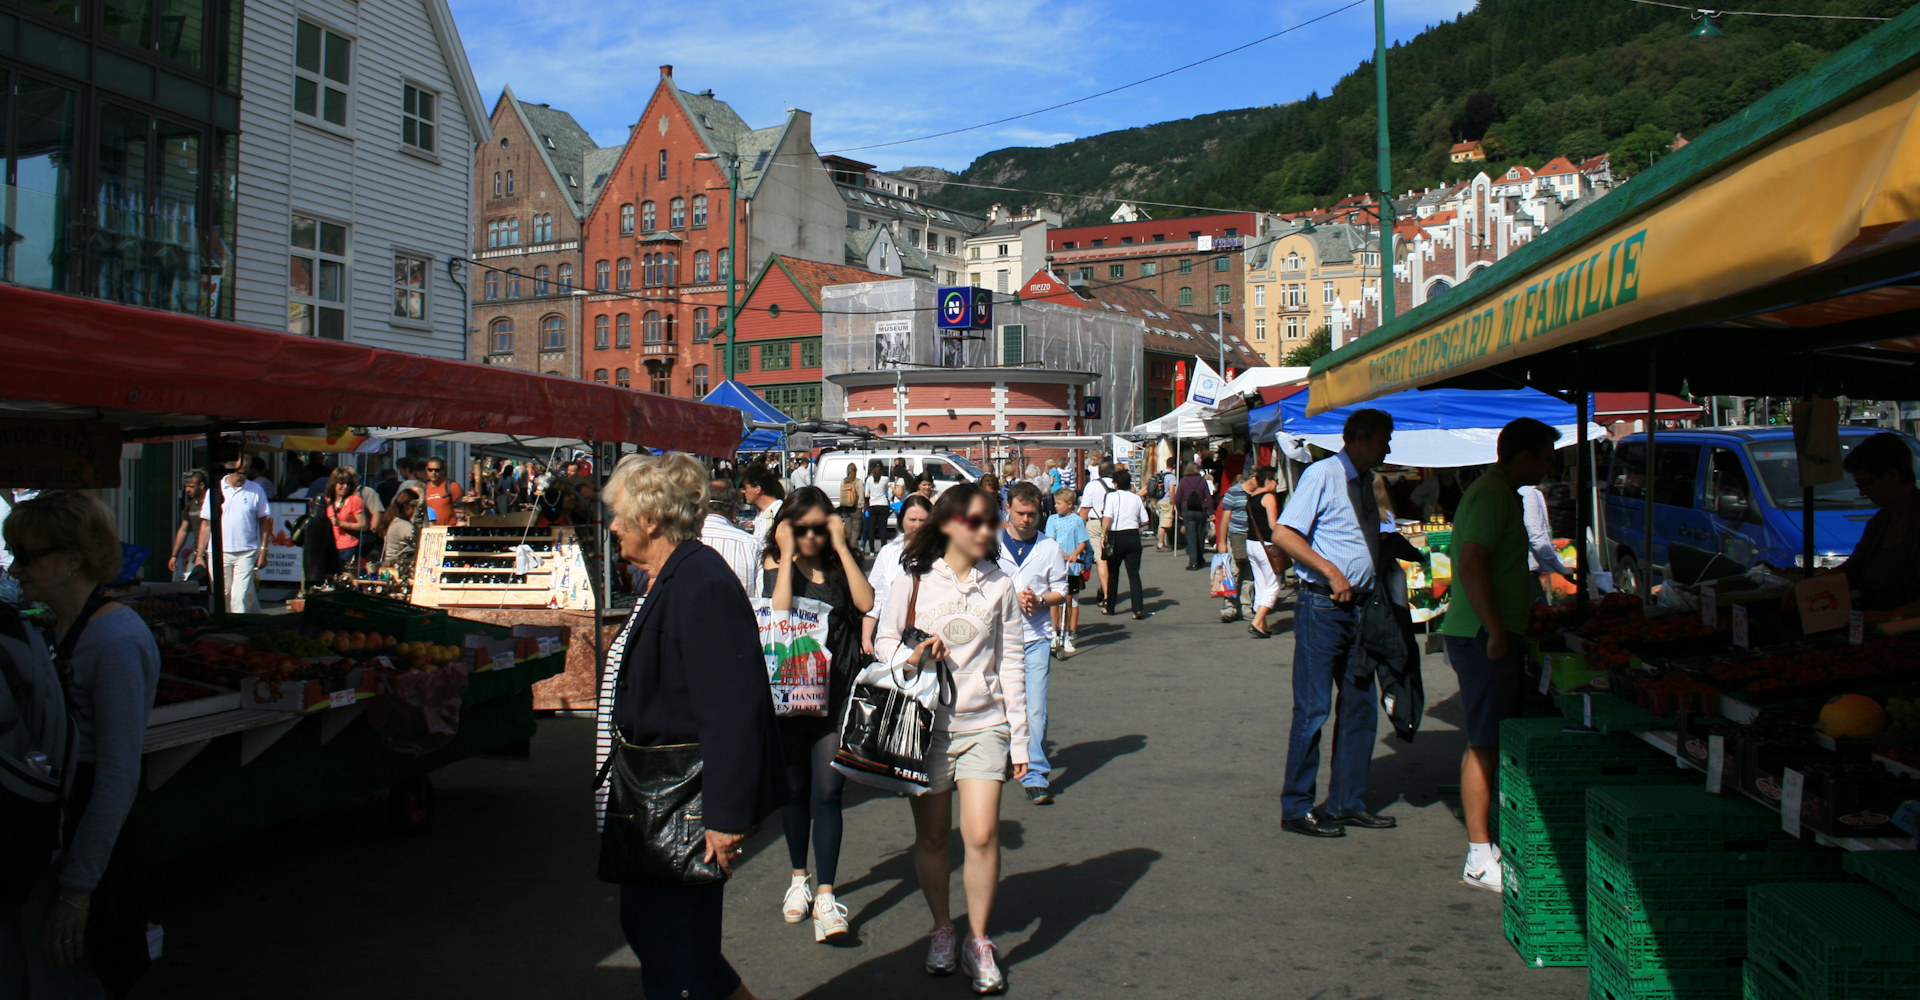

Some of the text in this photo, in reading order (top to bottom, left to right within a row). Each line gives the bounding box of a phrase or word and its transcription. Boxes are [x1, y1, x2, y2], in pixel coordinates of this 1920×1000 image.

[1030, 283, 1050, 292] mezzo
[949, 301, 959, 315] N
[978, 301, 985, 315] N
[1087, 403, 1095, 413] N
[951, 624, 968, 636] NY
